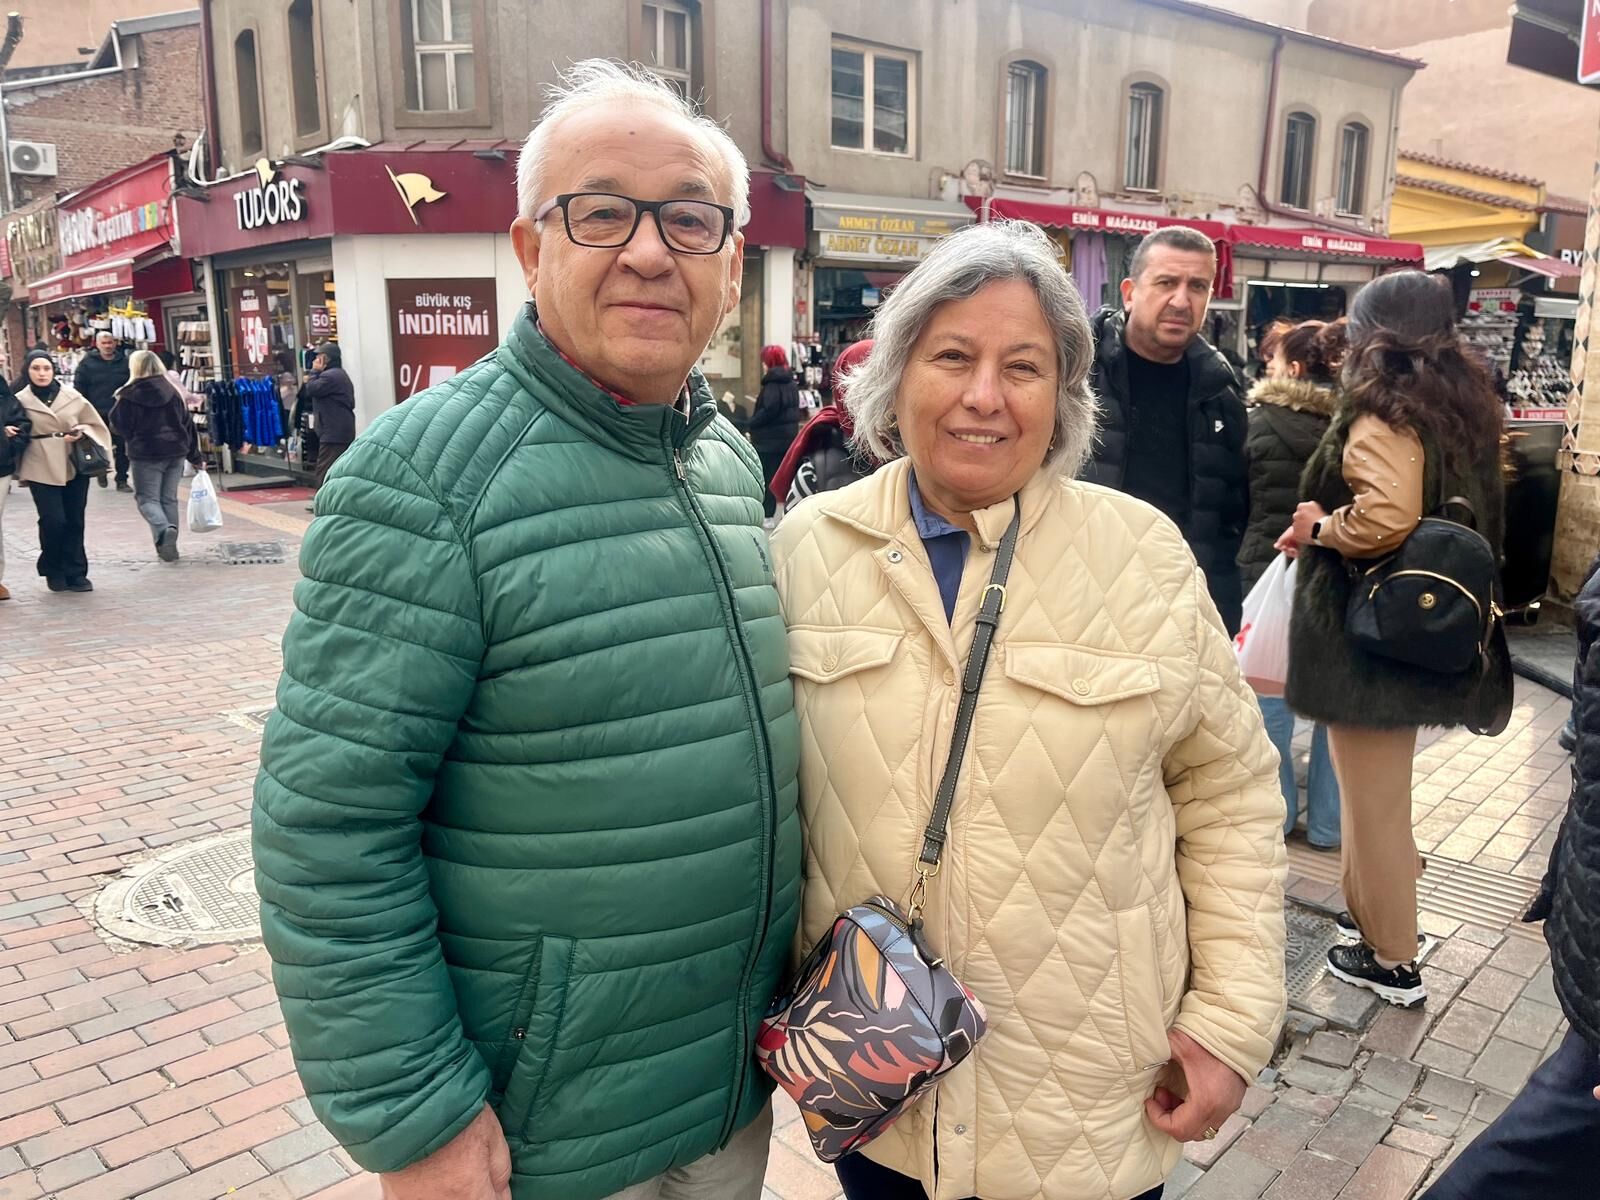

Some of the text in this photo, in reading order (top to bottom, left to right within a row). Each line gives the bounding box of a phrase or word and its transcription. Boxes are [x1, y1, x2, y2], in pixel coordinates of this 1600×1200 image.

[233, 178, 301, 230] TUDORS
[840, 216, 877, 231] AHMET
[1072, 211, 1158, 231] EMİN MAĞAZASI
[415, 293, 472, 310] BÜYÜK KIŞ
[311, 314, 329, 327] 50
[398, 309, 490, 335] İNDİRİMİ
